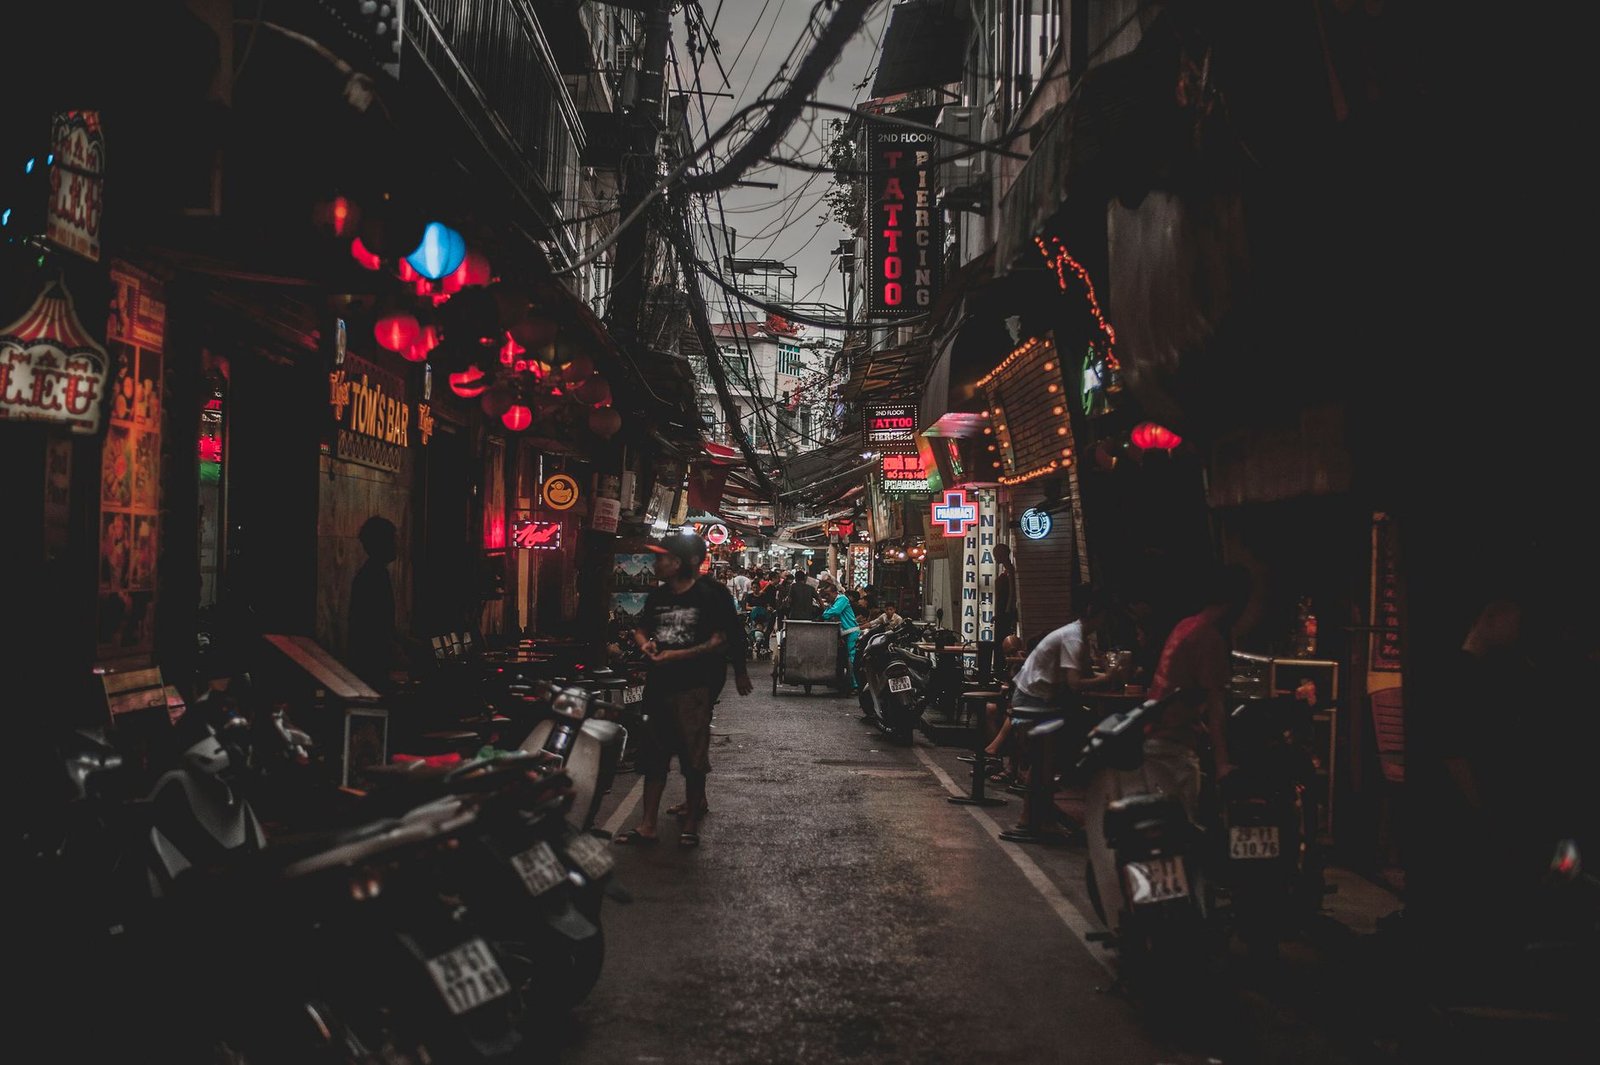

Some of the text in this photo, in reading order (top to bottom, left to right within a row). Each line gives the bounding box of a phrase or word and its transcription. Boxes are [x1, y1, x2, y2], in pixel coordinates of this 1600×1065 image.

[877, 133, 933, 143] 2ND FLOOR
[882, 151, 904, 306] TATTOO
[915, 151, 931, 306] PIERCING
[385, 397, 409, 447] BAR
[868, 418, 913, 428] TATTOO
[980, 514, 994, 564] NHÀ
[963, 523, 977, 643] PHARMAC
